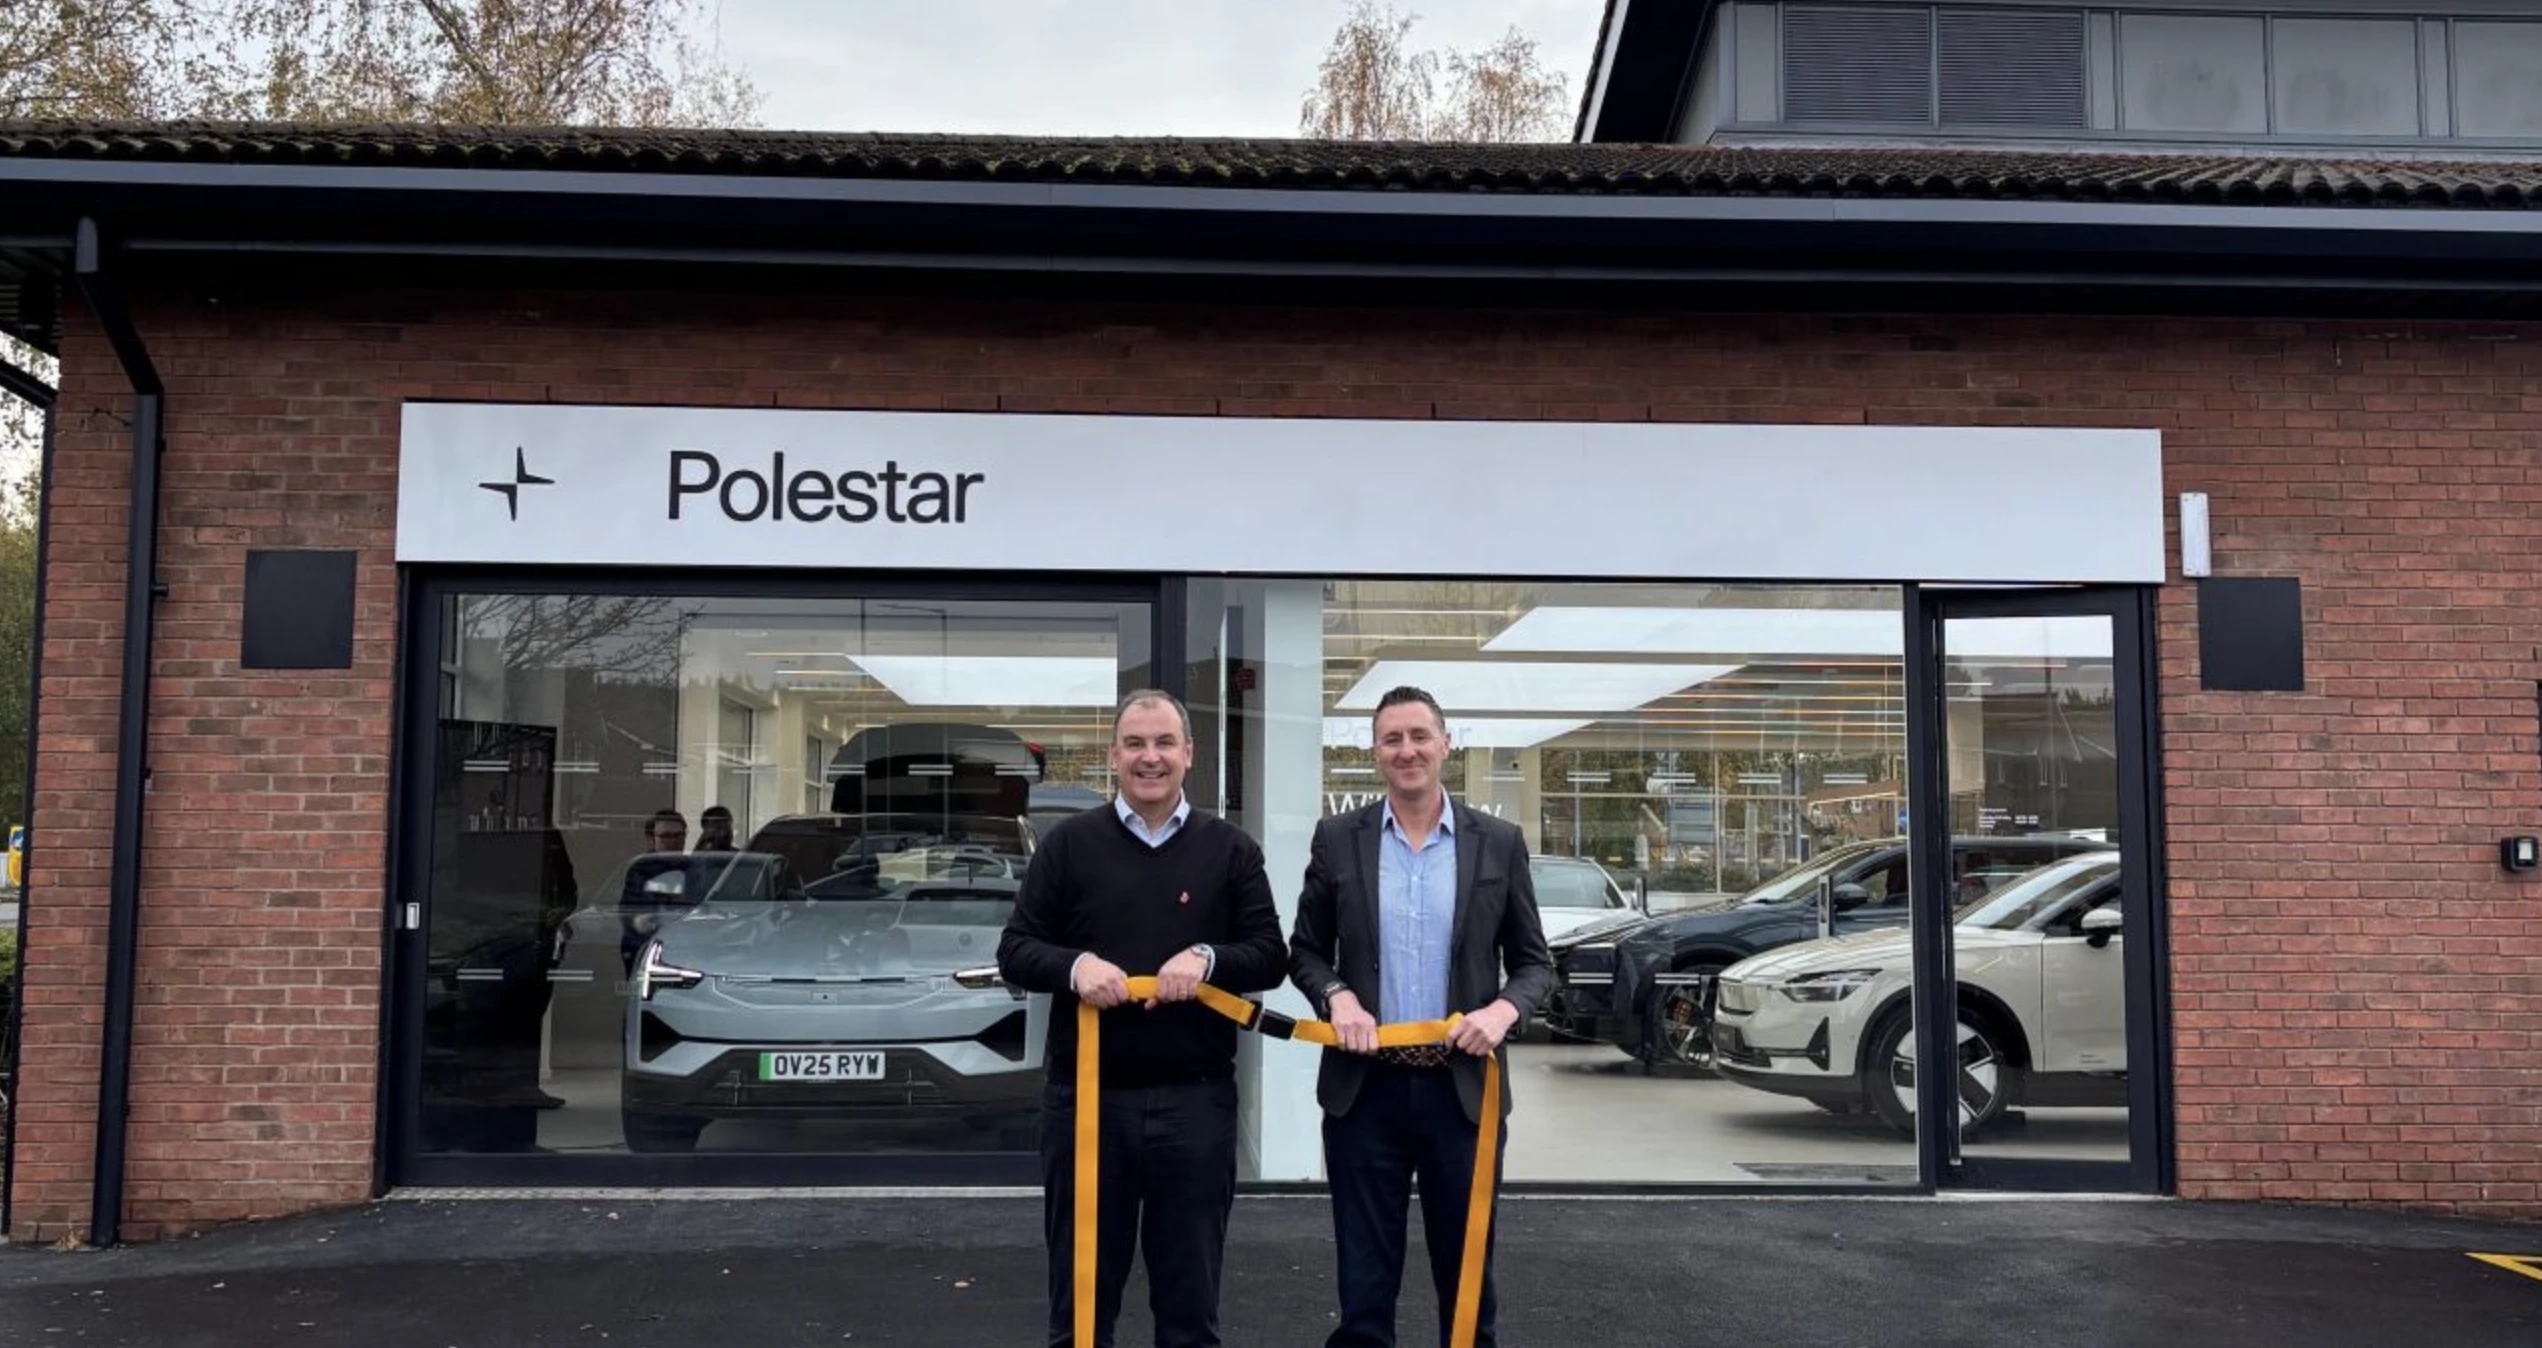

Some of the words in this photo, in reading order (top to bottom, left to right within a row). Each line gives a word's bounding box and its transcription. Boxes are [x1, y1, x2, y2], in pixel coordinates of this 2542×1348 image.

[668, 450, 985, 524] Polestar
[774, 1054, 831, 1076] OV25
[837, 1054, 880, 1076] RYW
